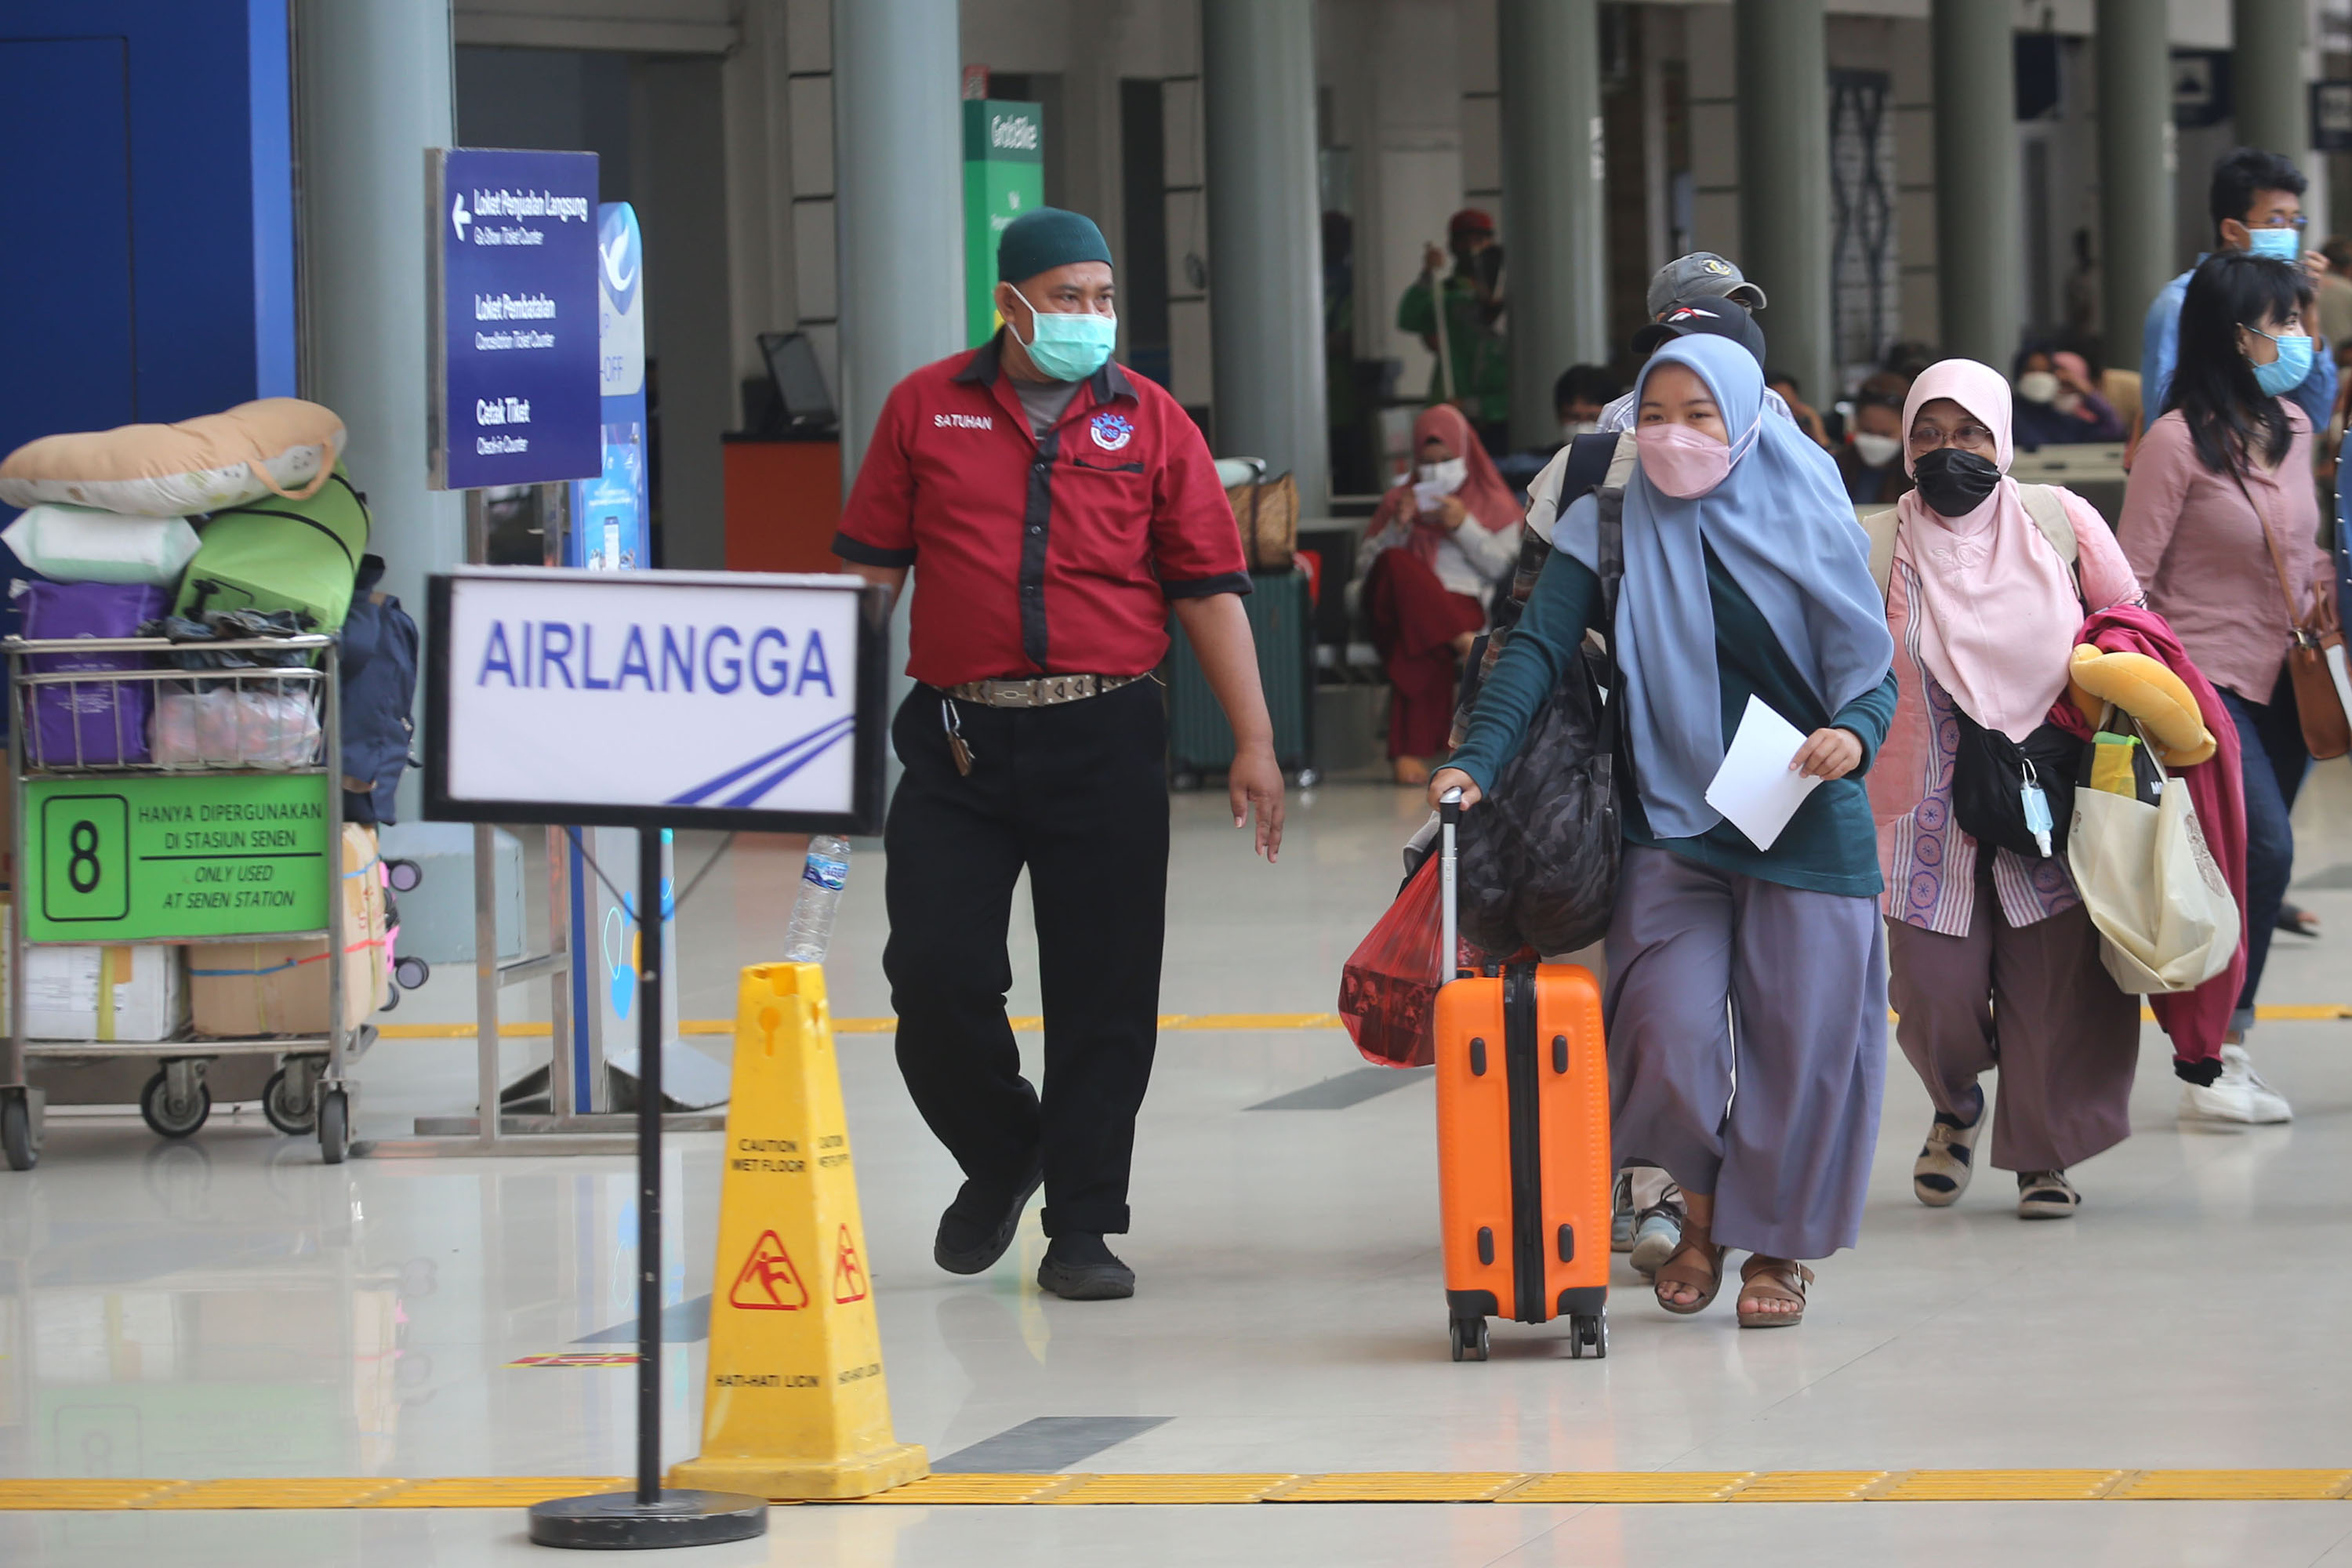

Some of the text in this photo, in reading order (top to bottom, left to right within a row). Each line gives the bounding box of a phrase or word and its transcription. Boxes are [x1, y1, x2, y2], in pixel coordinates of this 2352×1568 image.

[991, 114, 1037, 150] GrabBike
[474, 188, 588, 223] Loket Penjualan Langsung
[475, 292, 556, 321] Loket Pembatalan
[476, 397, 531, 426] Cetak Tiket
[935, 414, 993, 430] SATUHAN
[476, 619, 836, 698] AIRLANGGA
[139, 803, 322, 822] HANYA DIPERGUNAKAN
[165, 830, 296, 849] DI STASIUN SENEN
[69, 819, 100, 893] 8
[194, 865, 273, 882] ONLY USED
[162, 890, 295, 909] AT SENEN STATION
[739, 1138, 798, 1152] CAUTION
[731, 1159, 806, 1172] WET FLOOR
[715, 1374, 819, 1388] HATI-HATI LICIN
